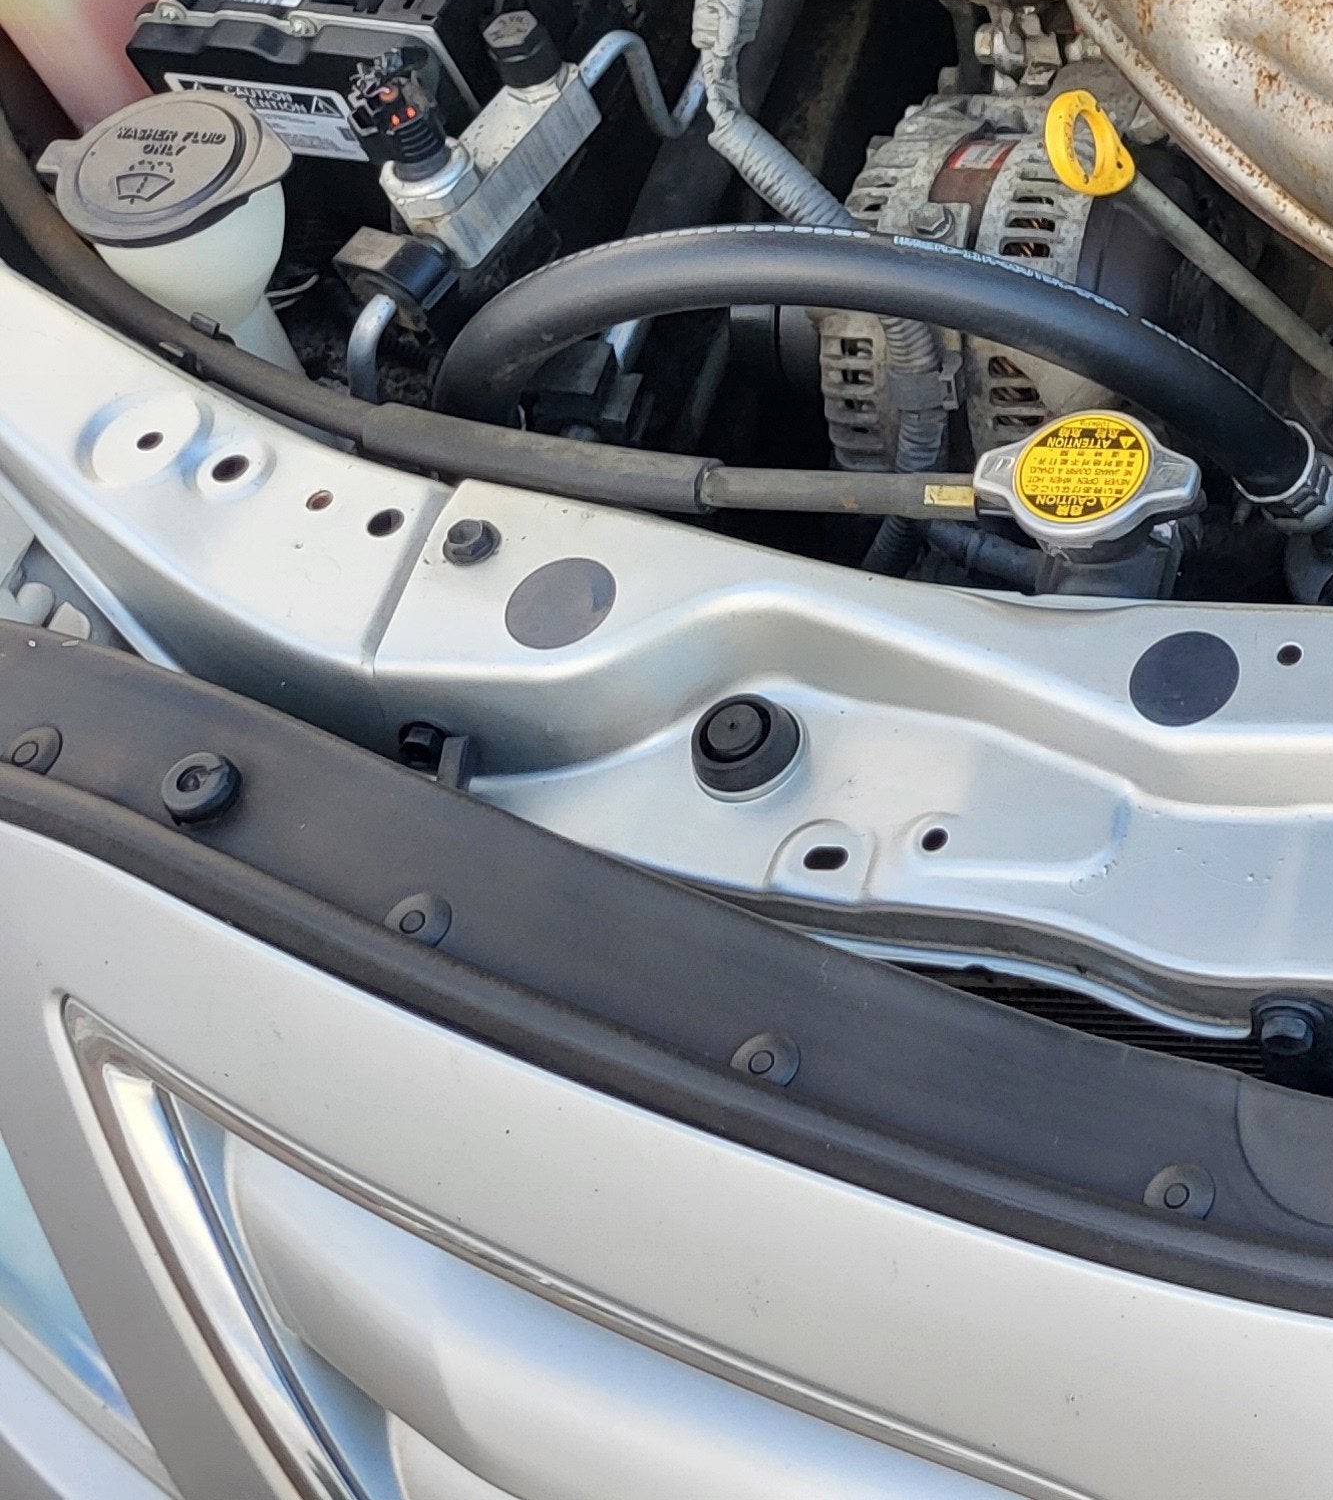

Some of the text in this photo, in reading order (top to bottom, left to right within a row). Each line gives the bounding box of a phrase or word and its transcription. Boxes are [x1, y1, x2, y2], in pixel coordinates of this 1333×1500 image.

[142, 143, 187, 156] ONLY
[1047, 436, 1112, 448] ATTENTION
[1050, 476, 1072, 484] WHEN
[1077, 477, 1099, 485] OPEN
[1104, 478, 1131, 486] NEVER
[1036, 495, 1097, 506] CAUTION
